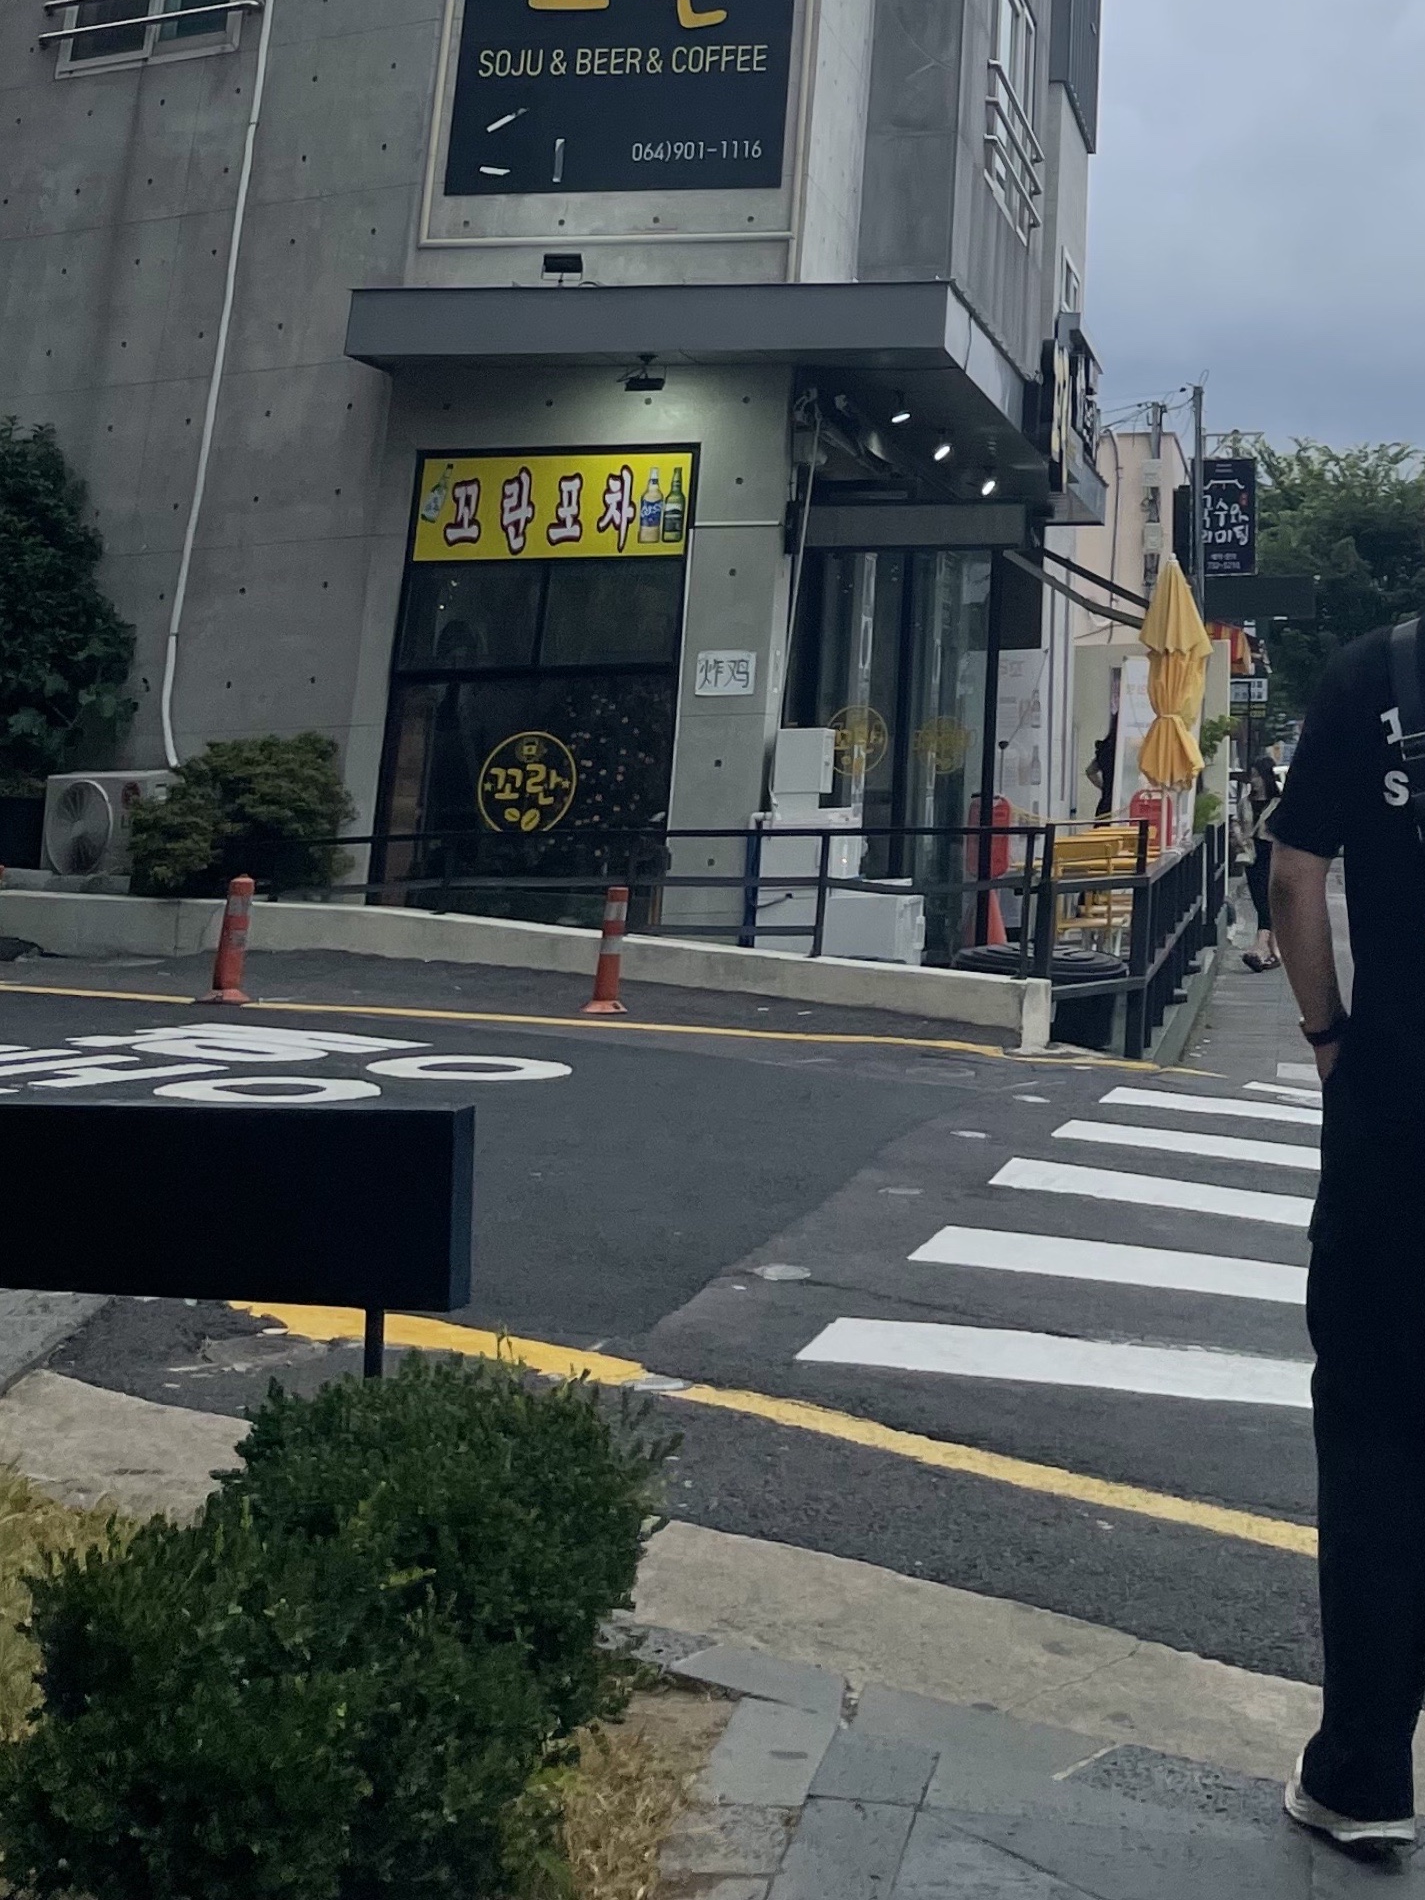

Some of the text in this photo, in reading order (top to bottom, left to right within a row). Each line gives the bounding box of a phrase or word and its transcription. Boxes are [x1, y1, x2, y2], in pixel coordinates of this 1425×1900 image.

[478, 45, 768, 78] SOJU & BEER & COFFEE
[631, 140, 763, 162] 064)901-1116
[444, 464, 635, 556] 꼬란포차
[698, 658, 750, 690] 炸鸡
[489, 763, 563, 806] 꼬란
